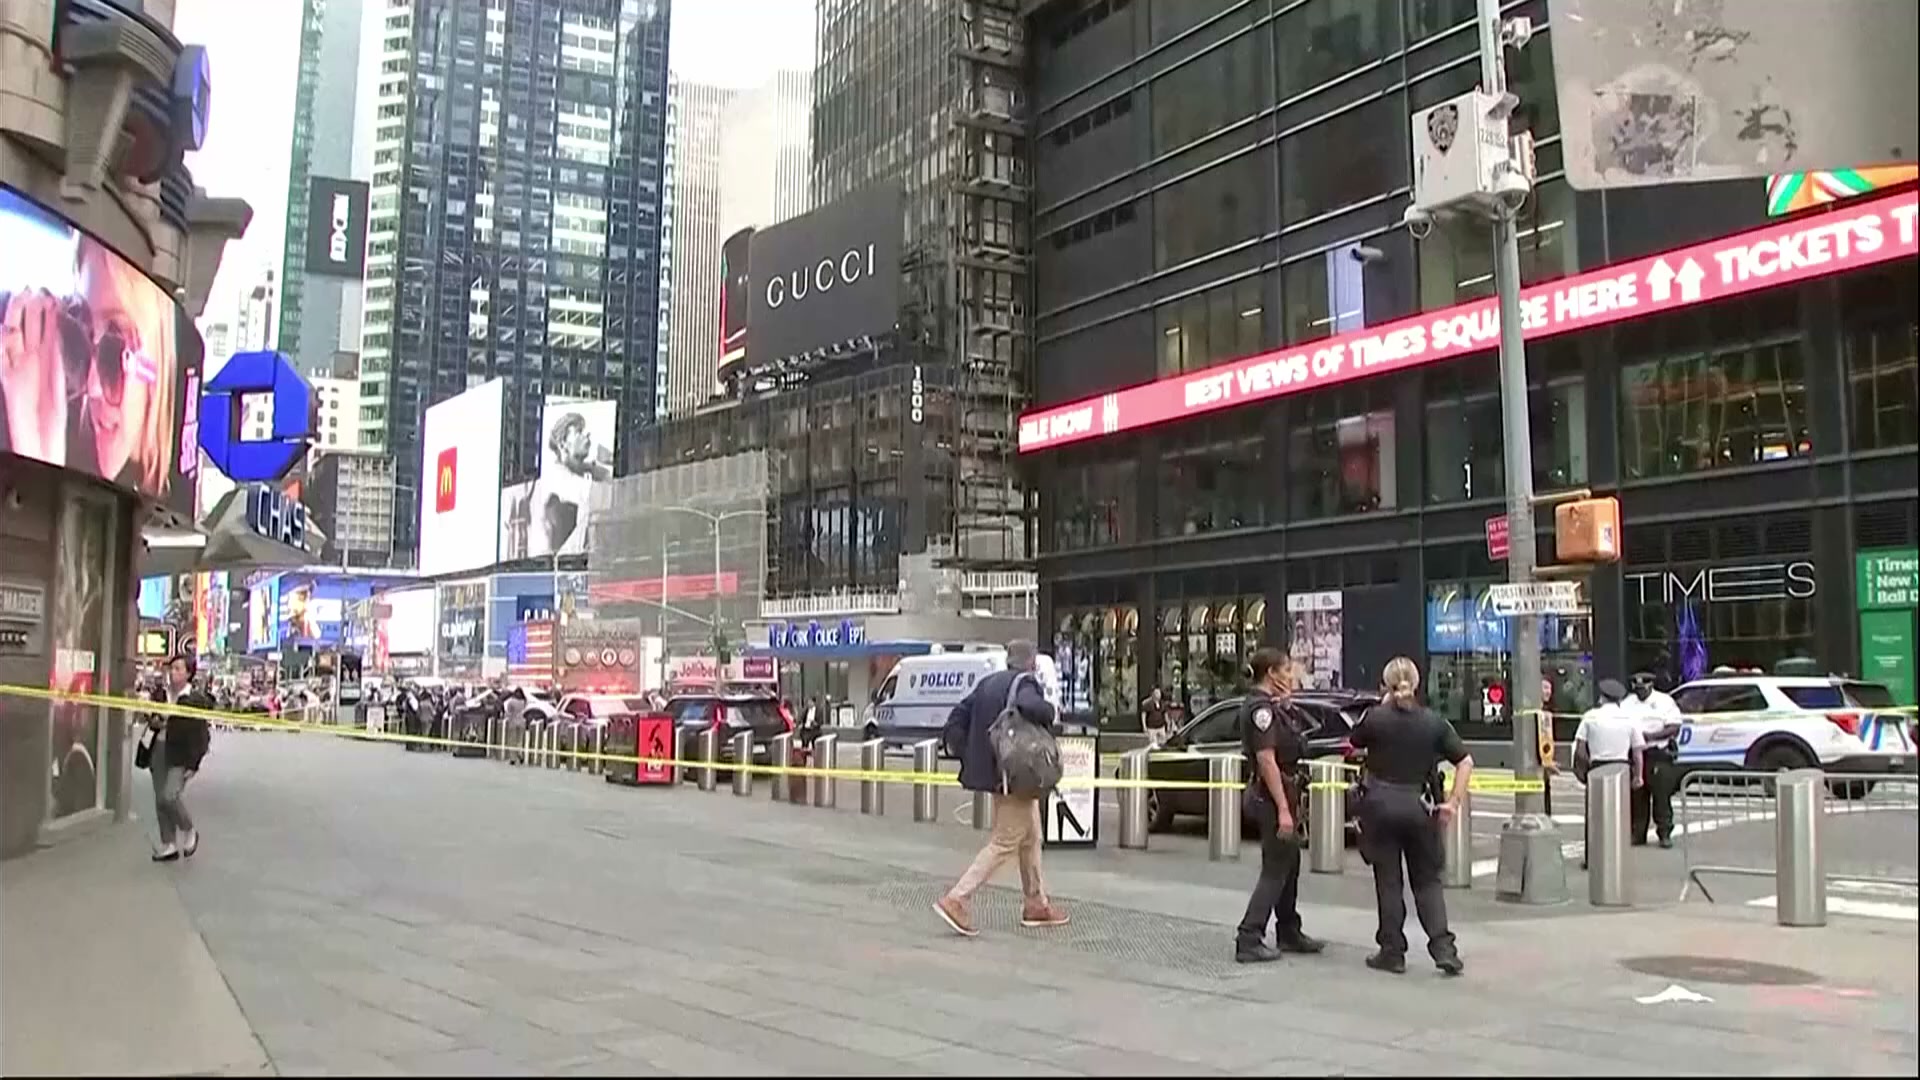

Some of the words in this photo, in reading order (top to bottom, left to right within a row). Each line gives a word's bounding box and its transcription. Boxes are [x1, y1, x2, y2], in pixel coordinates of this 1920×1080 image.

[1714, 215, 1885, 284] TICKETS
[766, 243, 875, 309] GUCCI
[1185, 370, 1233, 408] BEST
[1236, 355, 1308, 395] VIEWS
[1312, 345, 1347, 378] OF
[1350, 326, 1427, 369] TIMES
[1554, 273, 1638, 322] HERE
[911, 364, 926, 425] 1500
[1050, 407, 1093, 438] NOW
[1623, 562, 1816, 605] TIMES
[1877, 574, 1911, 588] New
[1877, 588, 1906, 604] Ball
[809, 620, 839, 647] POLICE
[920, 672, 963, 688] POLICE
